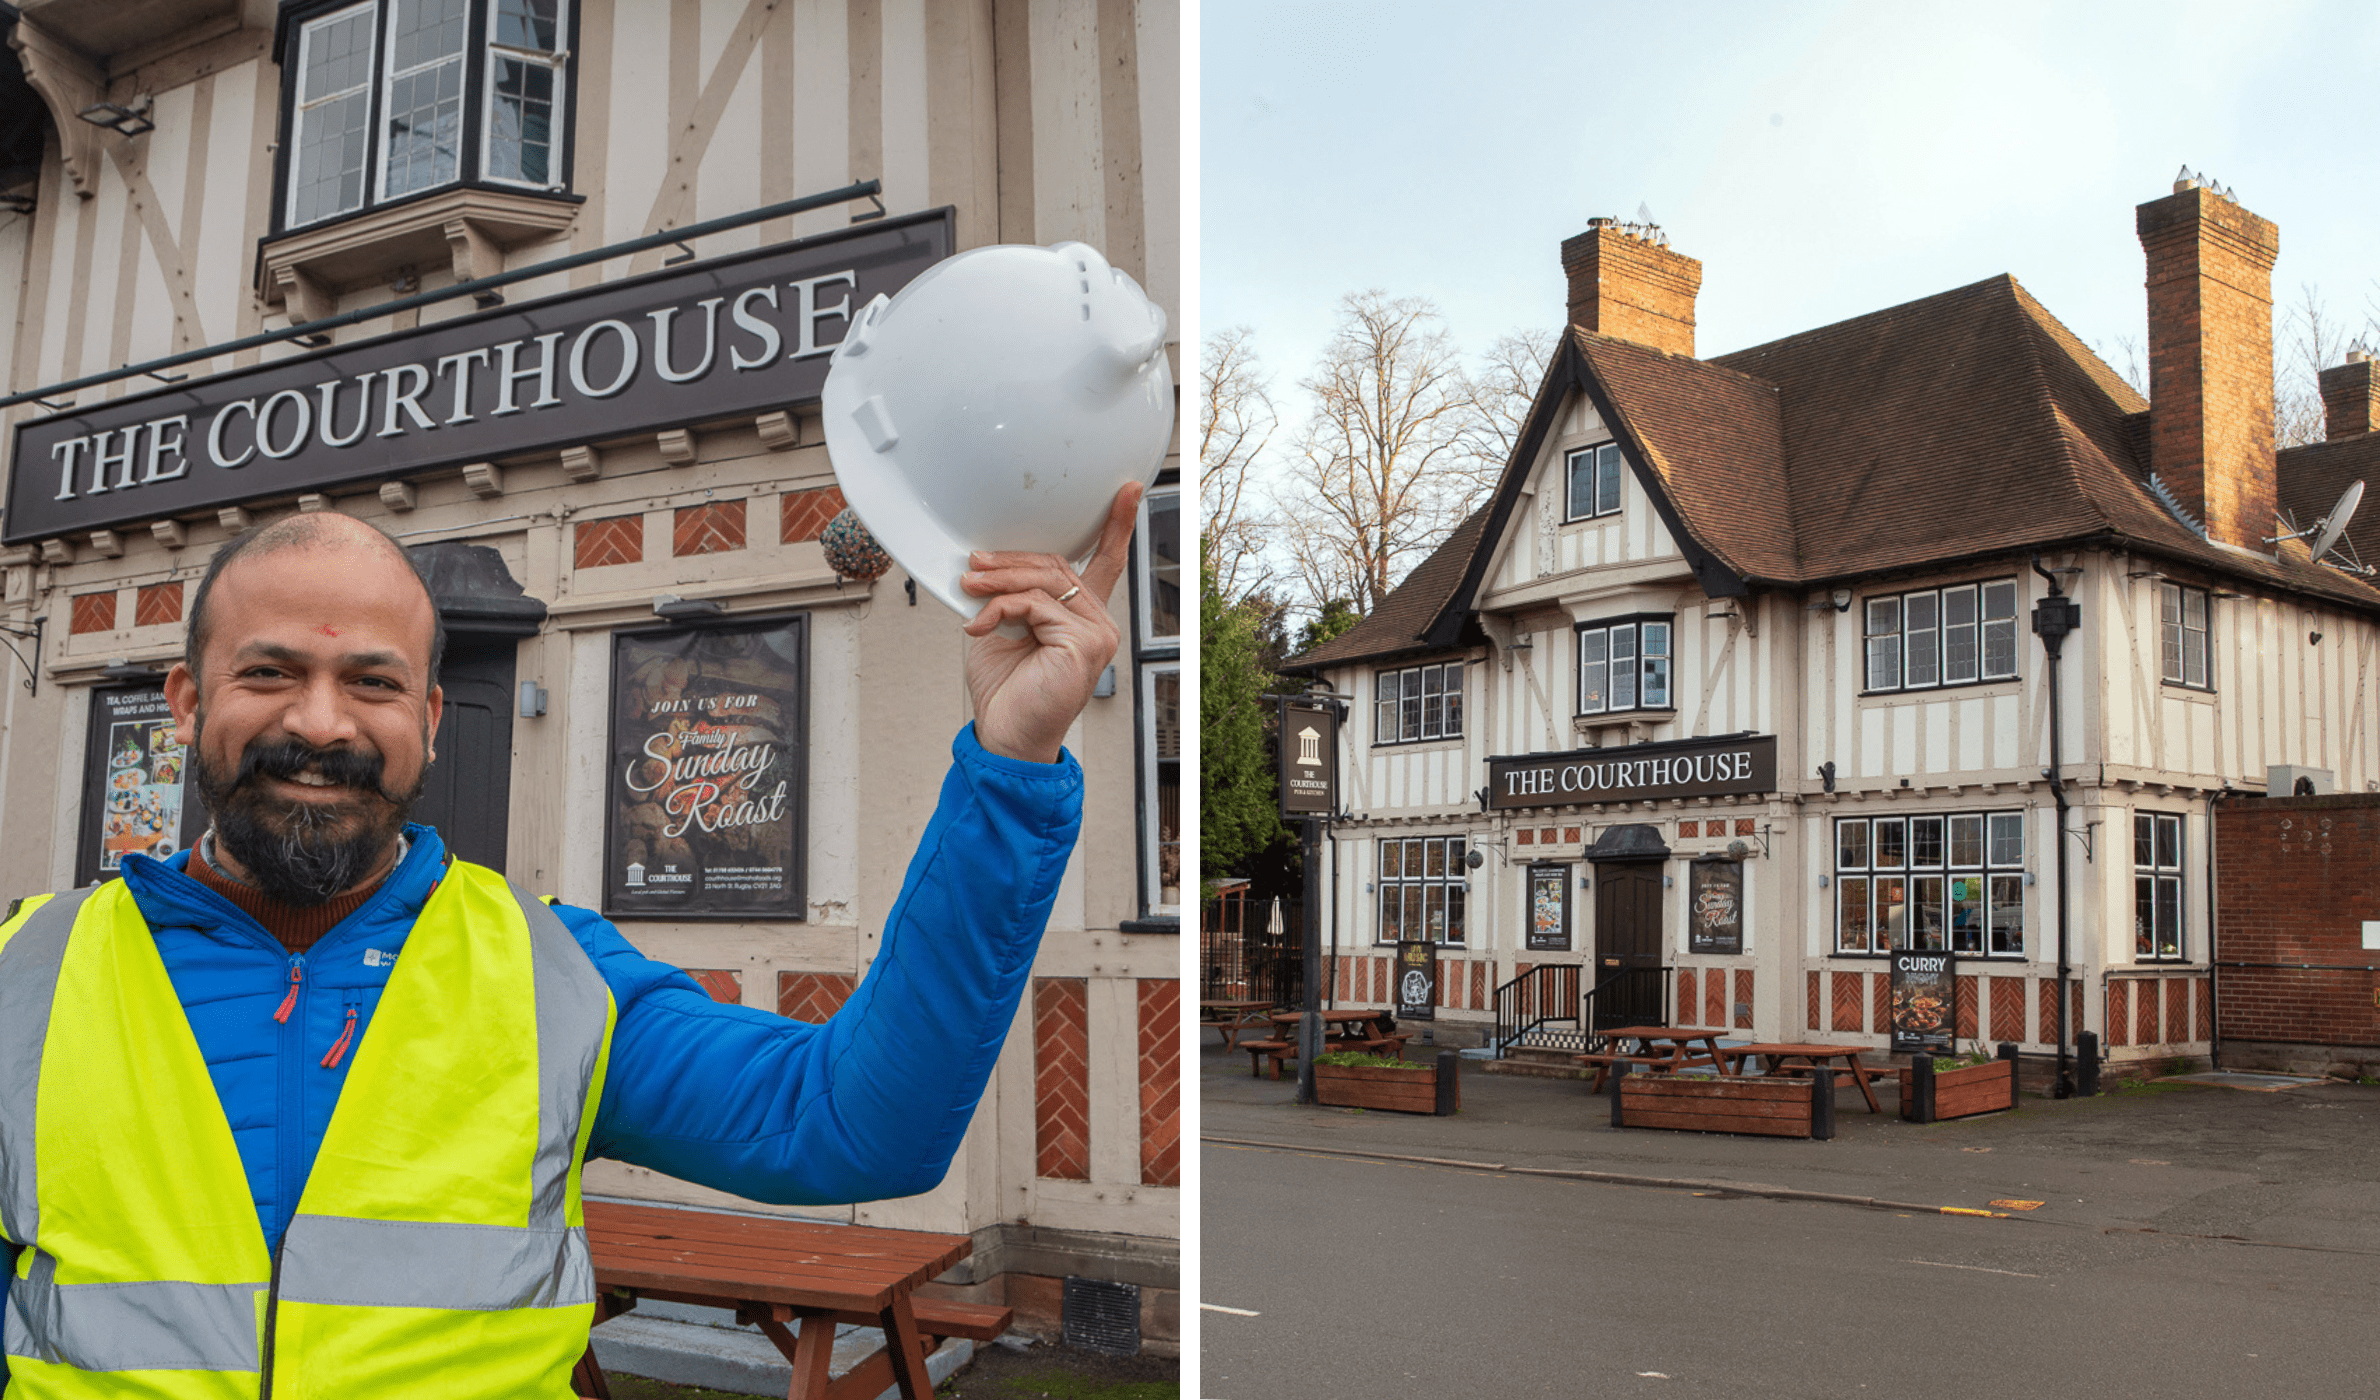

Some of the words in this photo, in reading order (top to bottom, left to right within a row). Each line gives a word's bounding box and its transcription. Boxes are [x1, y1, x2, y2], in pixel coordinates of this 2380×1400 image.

[51, 413, 189, 501] THE
[207, 269, 860, 469] COURTHOUSE
[113, 705, 138, 716] WRAPS
[139, 704, 156, 713] AND
[157, 702, 170, 713] HIG
[651, 699, 691, 714] JOIN
[698, 697, 717, 711] US
[724, 694, 758, 709] FOR
[679, 729, 727, 750] Family
[626, 732, 776, 792] Sunday
[1304, 770, 1315, 779] THE
[1505, 768, 1555, 796] THE
[1561, 751, 1752, 793] COURTHOUSE
[1290, 779, 1328, 790] COURTHOUSE
[663, 780, 787, 838] Roast
[648, 873, 693, 883] COURTHOUSE
[664, 864, 677, 873] THE
[1694, 893, 1735, 914] Sunday
[1704, 909, 1738, 929] Roast
[1898, 956, 1947, 972] CURRY
